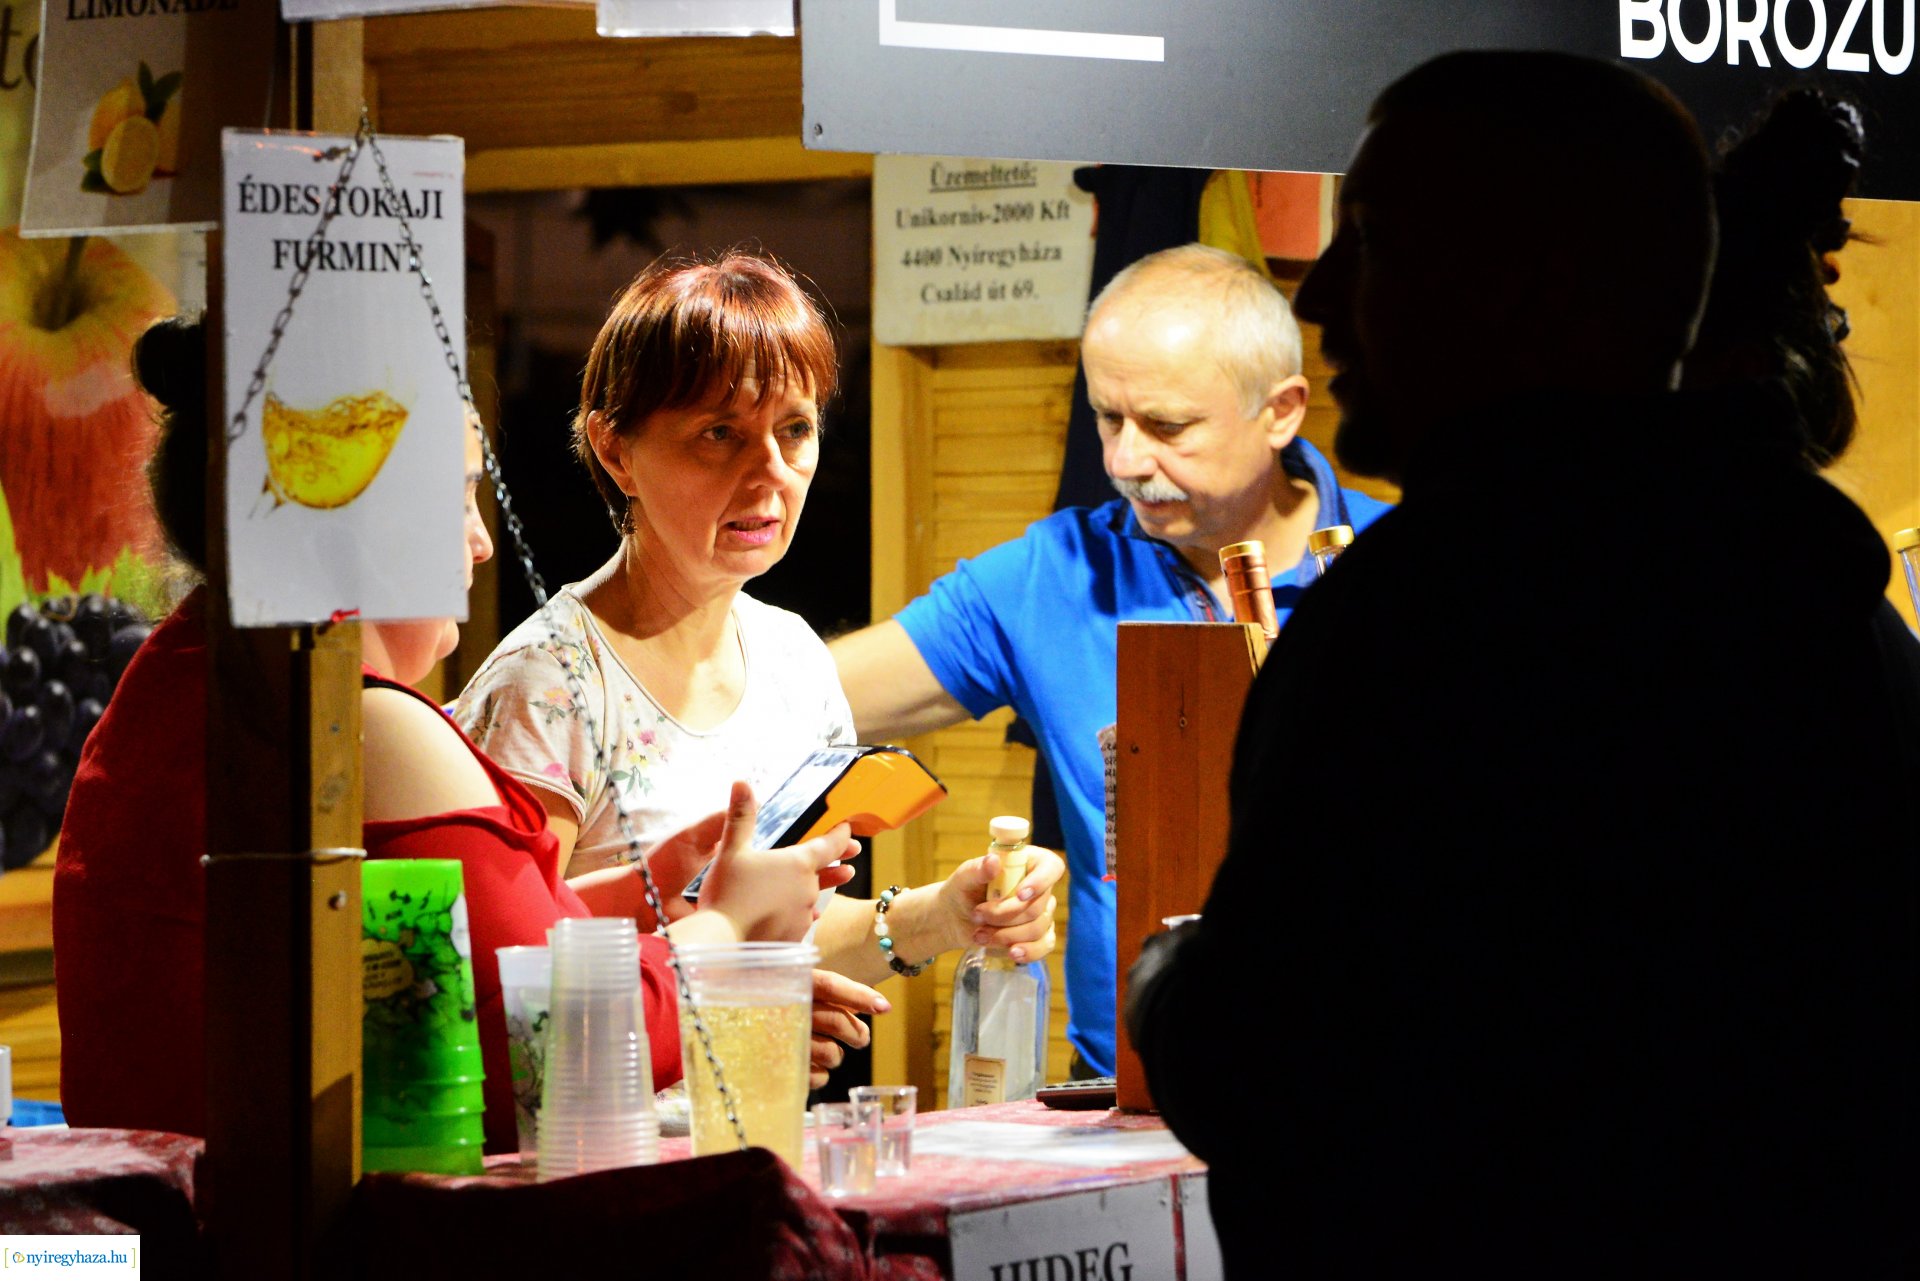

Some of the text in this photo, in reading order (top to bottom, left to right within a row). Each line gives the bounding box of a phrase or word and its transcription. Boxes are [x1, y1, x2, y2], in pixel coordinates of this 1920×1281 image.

[238, 174, 443, 220] ÉDES TOKAJI
[896, 200, 1070, 228] Unikornis-2000 Kft
[902, 241, 1063, 270] 4400 Nyíregyháza
[920, 281, 981, 304] Család
[988, 278, 1006, 300] út
